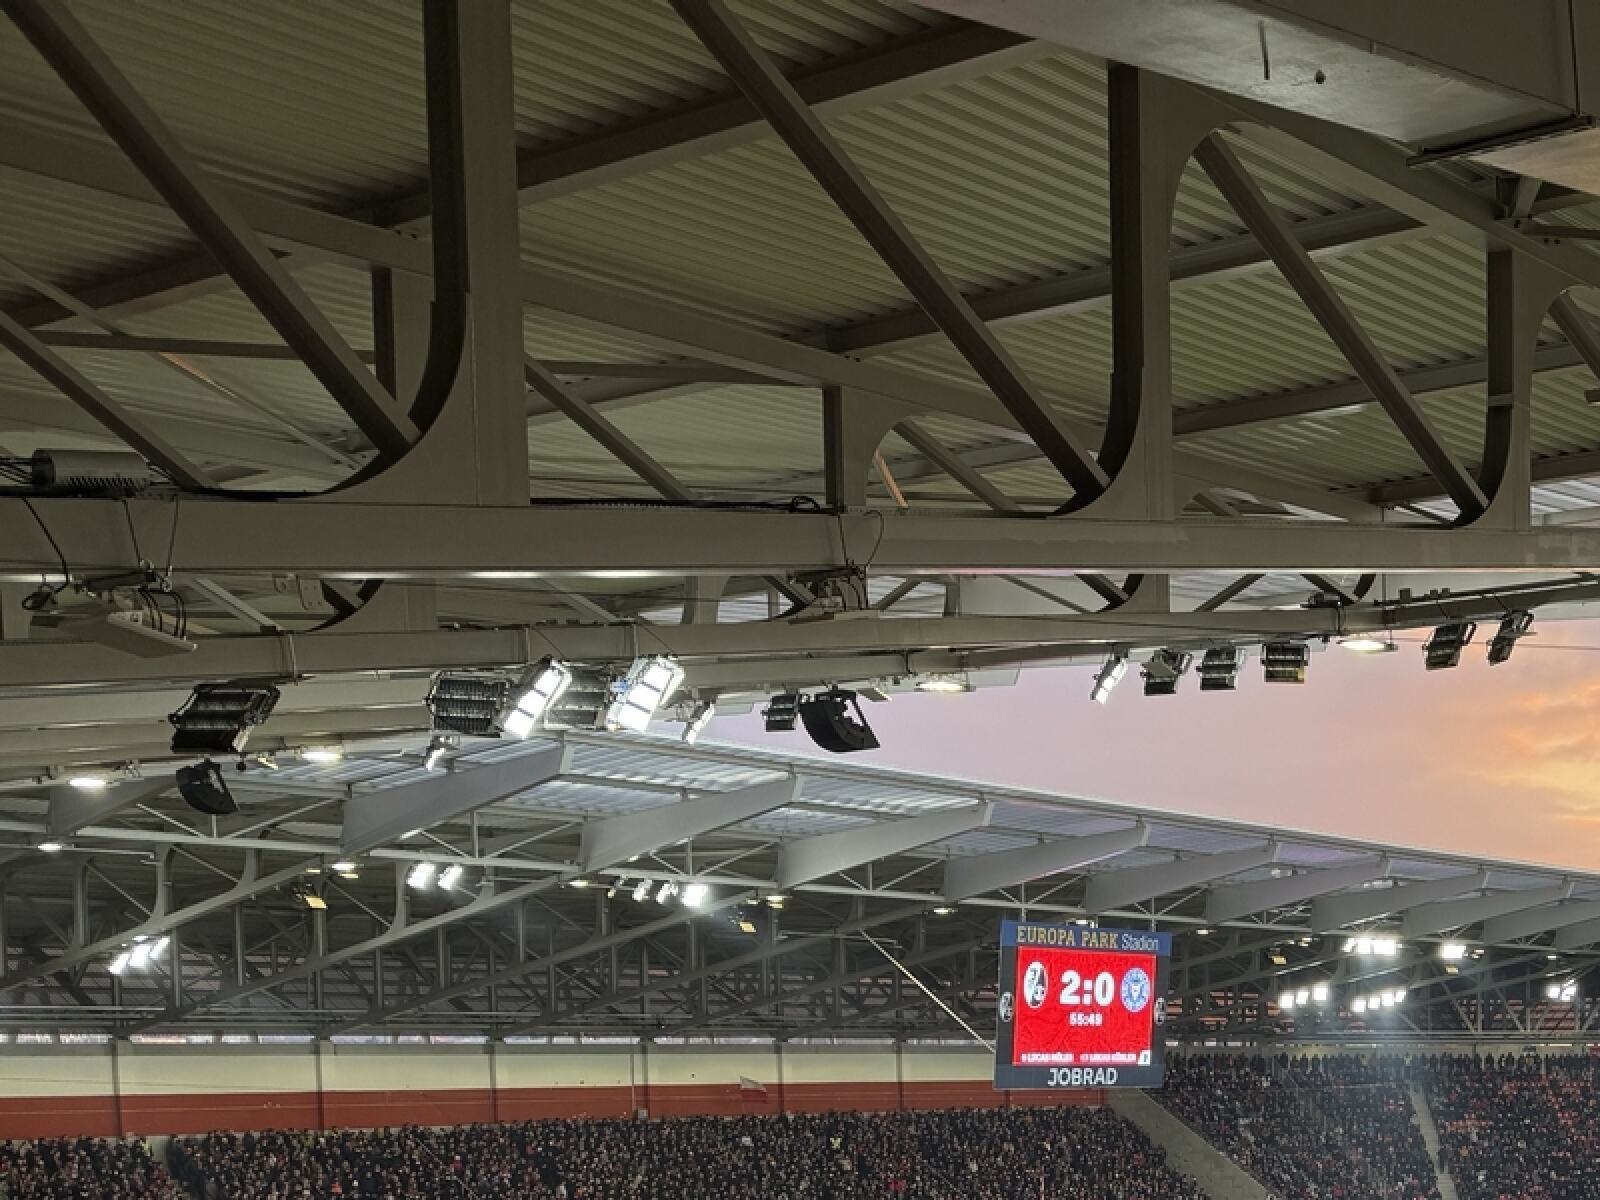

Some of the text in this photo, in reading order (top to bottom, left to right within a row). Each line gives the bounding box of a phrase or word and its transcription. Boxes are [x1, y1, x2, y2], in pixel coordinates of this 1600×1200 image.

[1016, 926, 1159, 951] EUROPA PARK Stadion
[1059, 969, 1115, 1006] 2:0
[1048, 1068, 1118, 1086] JOBRAD
